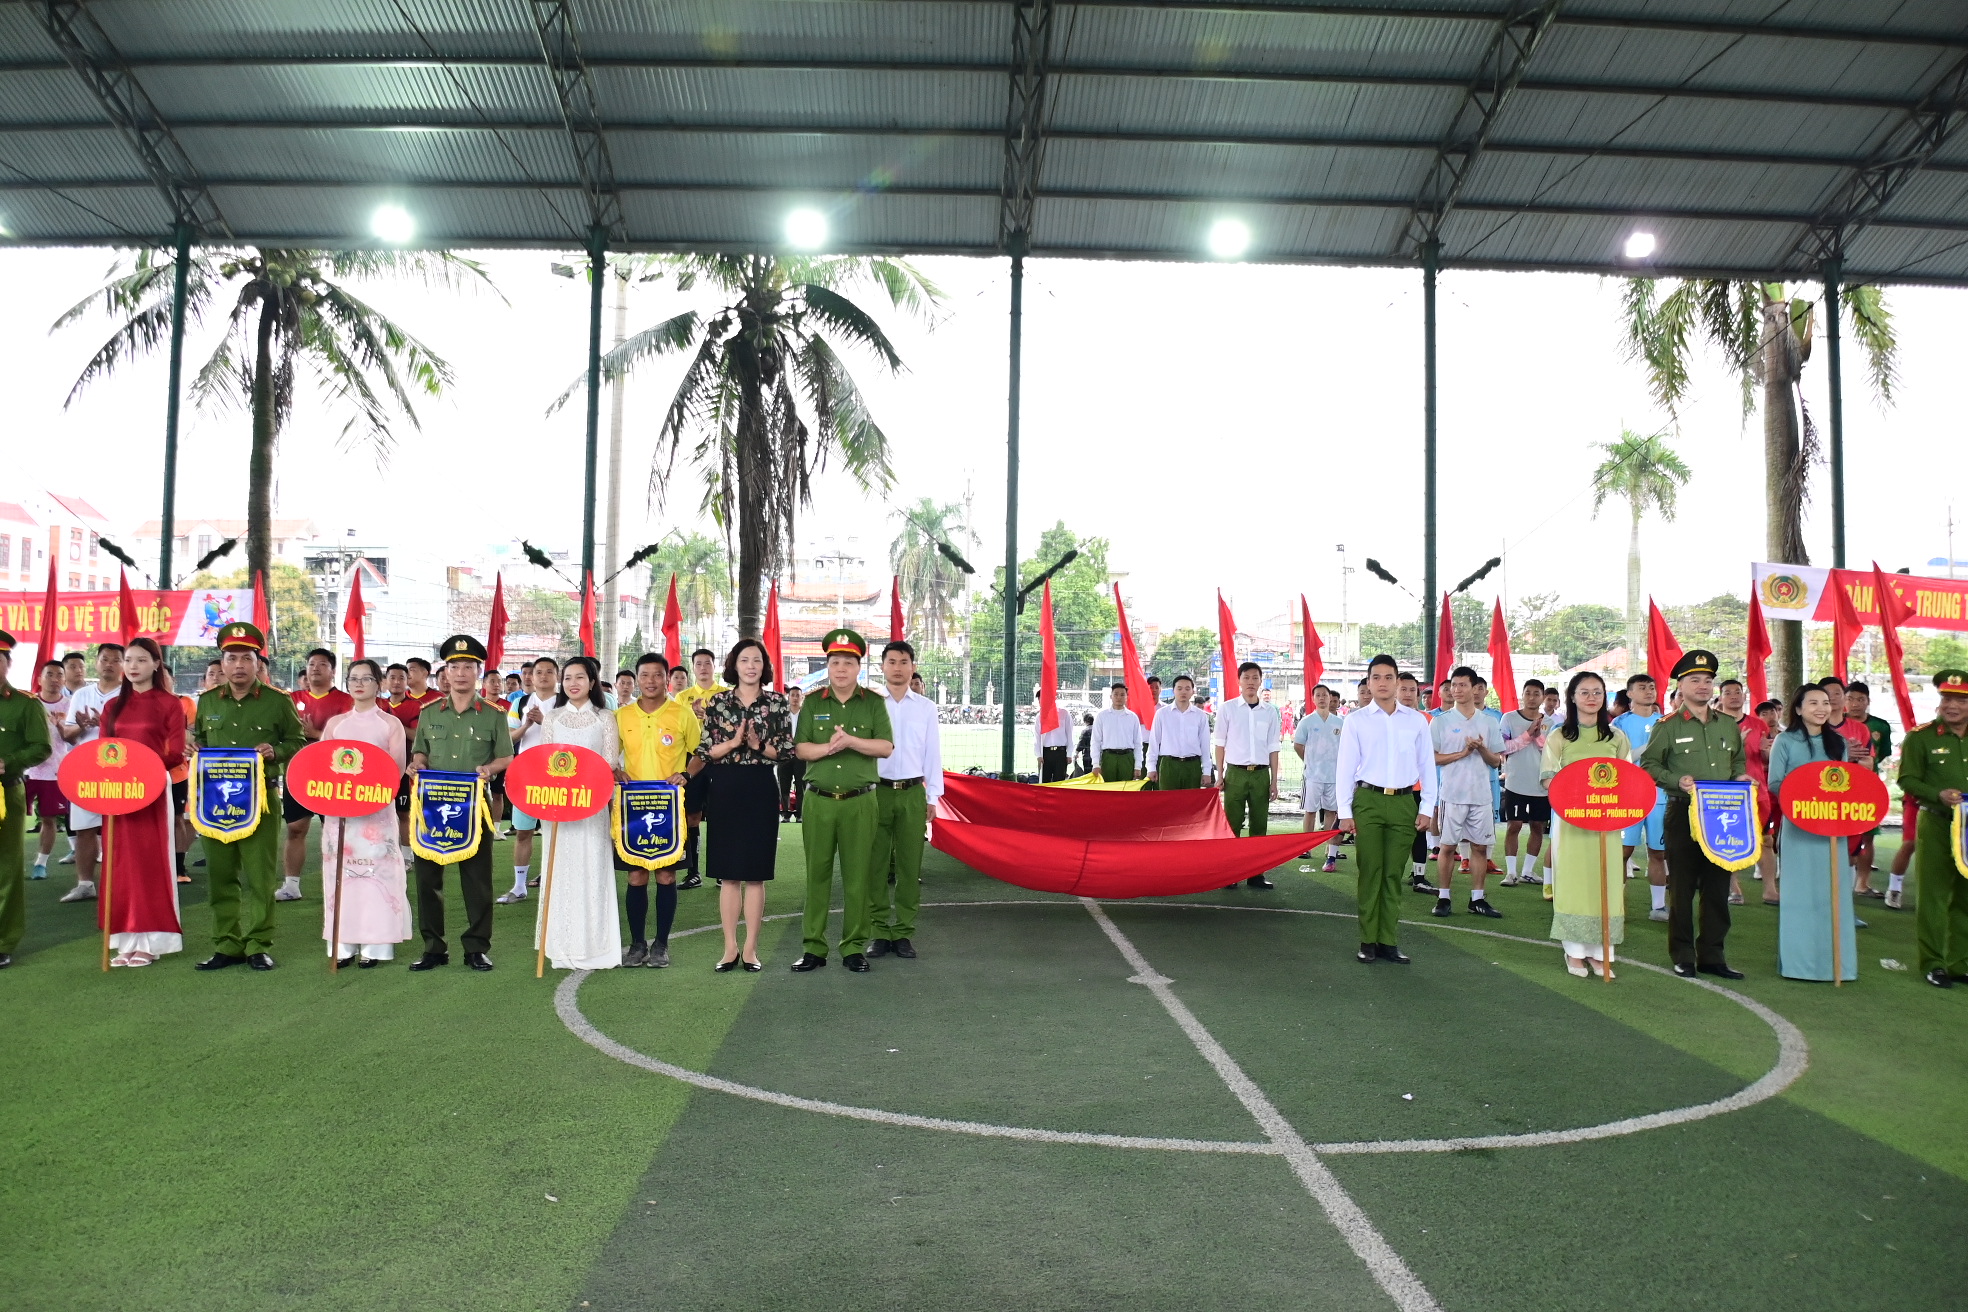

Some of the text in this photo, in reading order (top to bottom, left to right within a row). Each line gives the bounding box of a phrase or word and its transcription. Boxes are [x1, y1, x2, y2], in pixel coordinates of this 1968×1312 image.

[1845, 580, 1874, 613] ÀN
[1916, 590, 1961, 620] TRUNG
[7, 599, 30, 631] VÀ
[34, 605, 69, 632] BO
[73, 601, 94, 638] VỆ
[99, 596, 120, 632] TỔ
[137, 597, 172, 633] UỐC
[78, 776, 145, 799] CAH VĨNH BẢO
[306, 779, 393, 805] CAQ LÊ CHÂN
[399, 795, 408, 806] 17
[525, 784, 592, 810] TRỌNG TÀI
[1792, 796, 1877, 822] PHÒNG PC02
